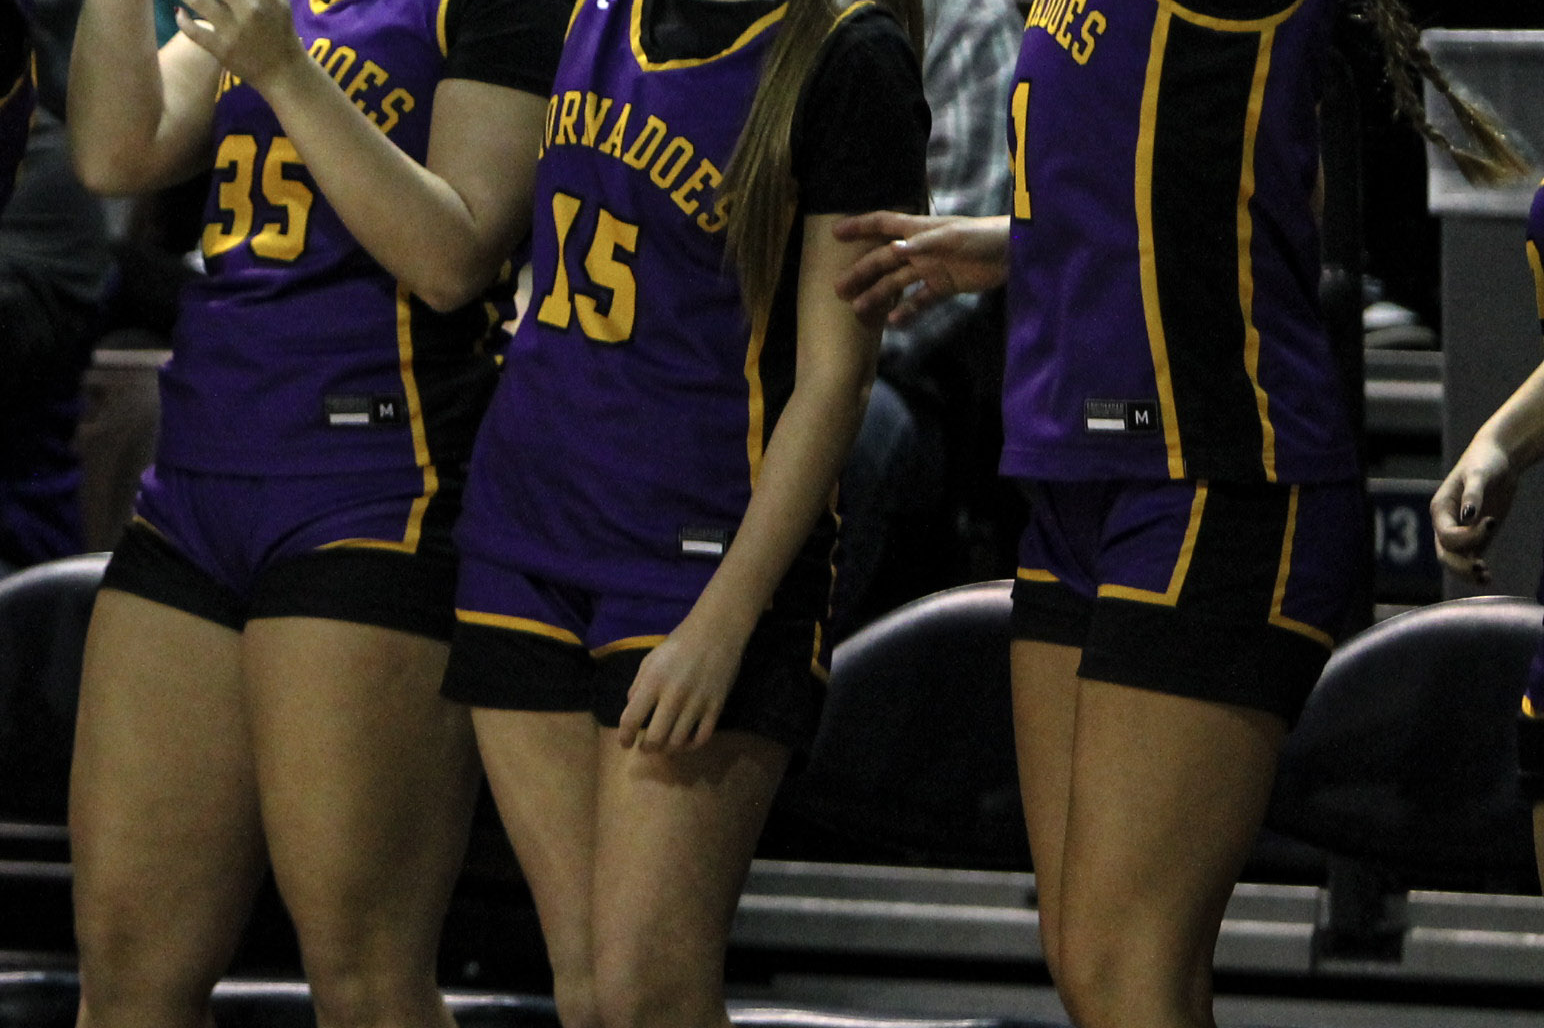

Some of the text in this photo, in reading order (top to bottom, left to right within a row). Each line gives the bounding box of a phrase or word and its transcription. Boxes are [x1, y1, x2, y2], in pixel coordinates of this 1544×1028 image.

[202, 134, 314, 262] 35
[536, 191, 639, 343] 15
[379, 403, 394, 418] M
[1135, 410, 1149, 425] M
